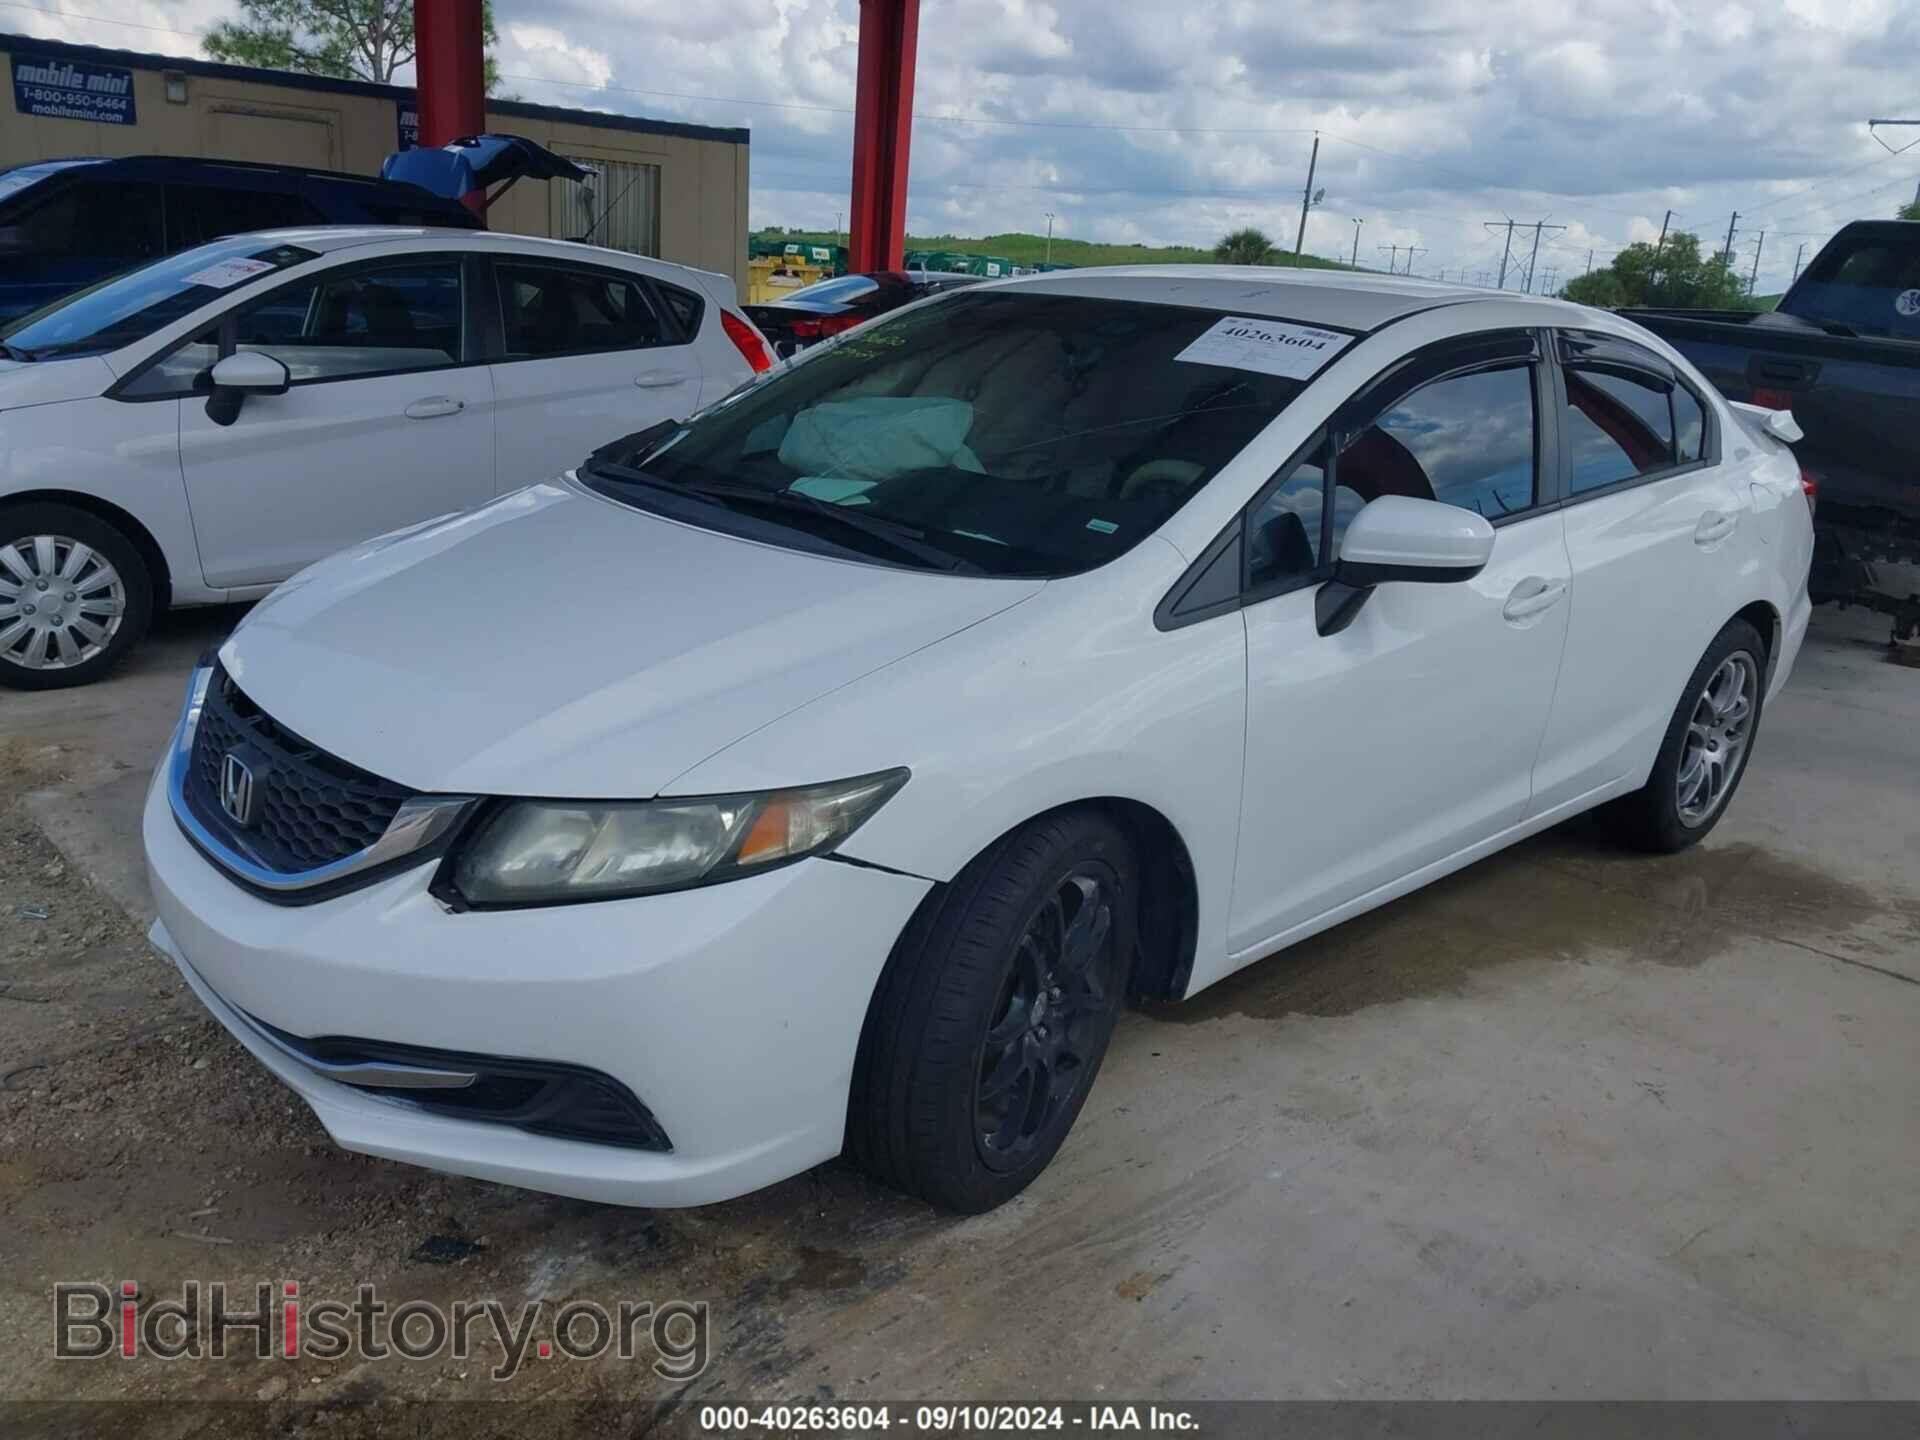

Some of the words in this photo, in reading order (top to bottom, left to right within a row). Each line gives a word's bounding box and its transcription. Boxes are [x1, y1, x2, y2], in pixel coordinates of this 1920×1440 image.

[16, 62, 83, 89] mobile
[87, 73, 129, 94] mini
[32, 104, 123, 122] mobilemini.com
[1222, 327, 1327, 350] 40263604
